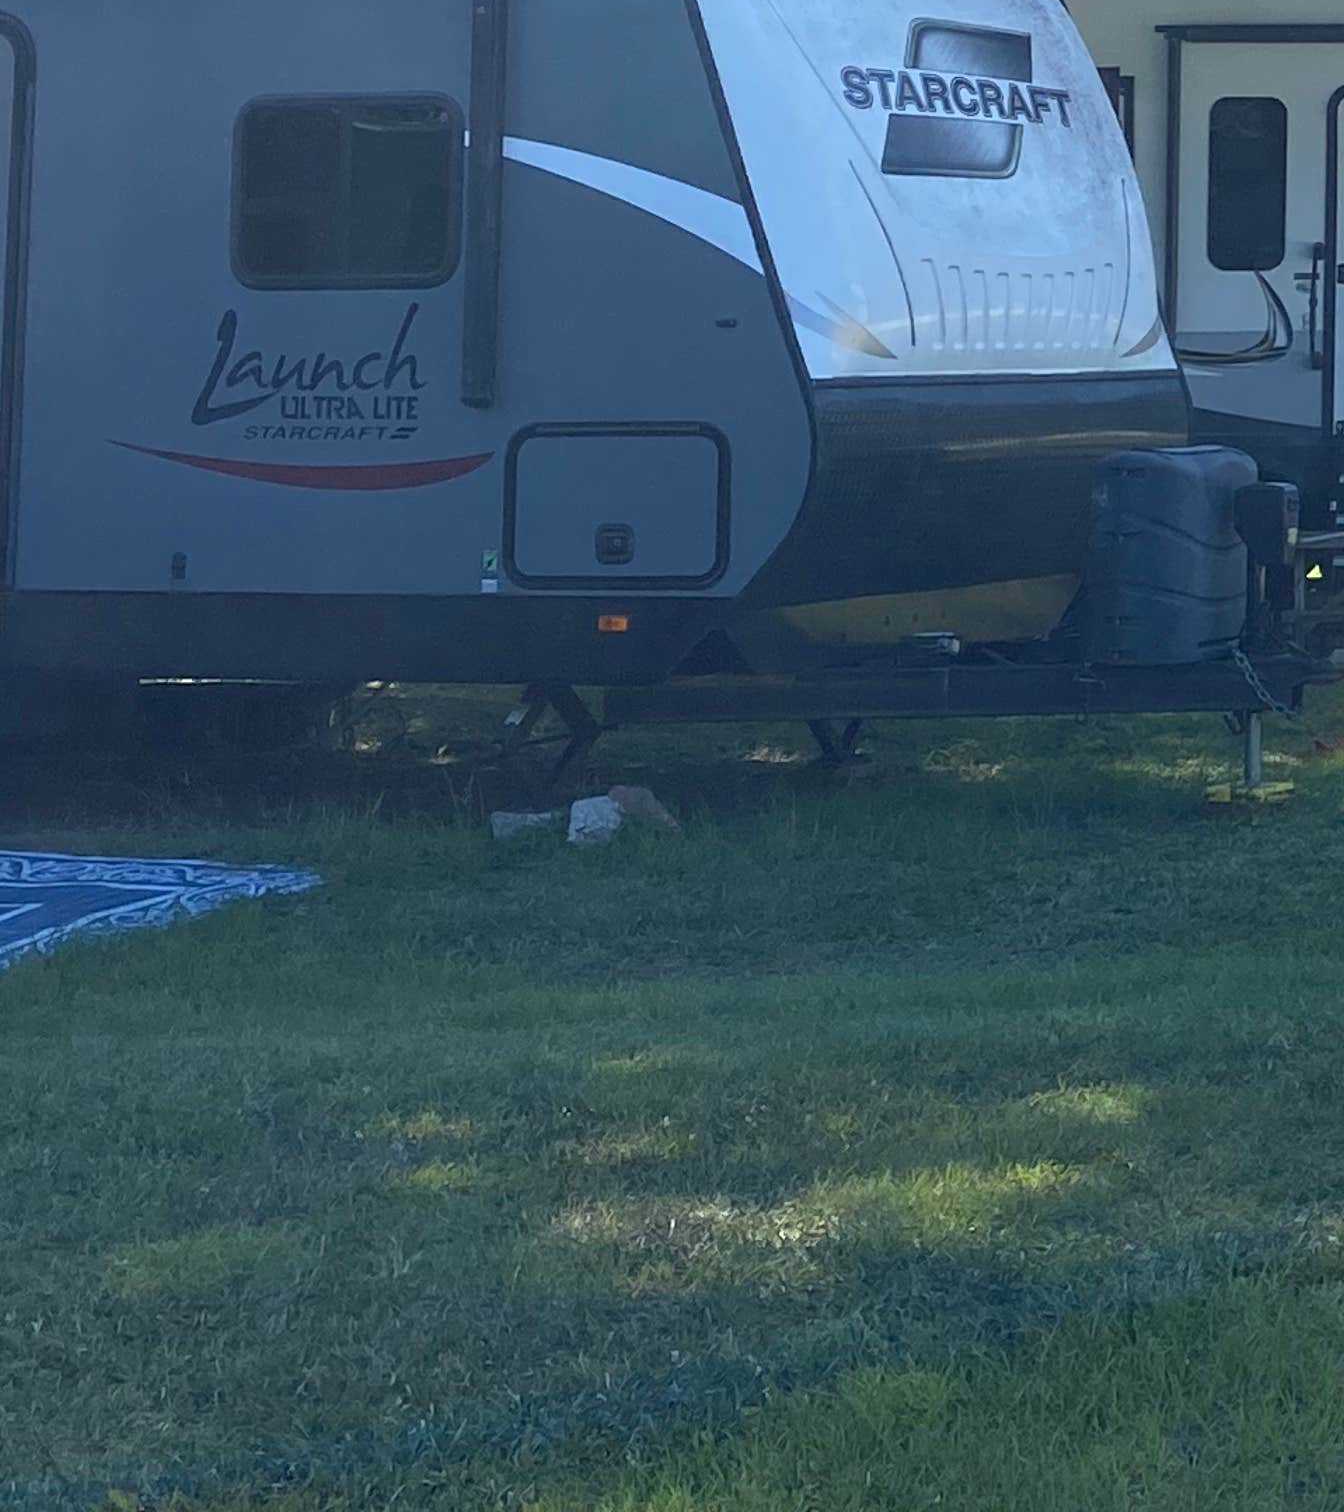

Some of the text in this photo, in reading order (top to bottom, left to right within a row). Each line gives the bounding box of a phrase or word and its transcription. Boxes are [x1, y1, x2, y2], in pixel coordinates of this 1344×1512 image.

[840, 65, 1072, 128] STARCRAFT
[191, 301, 428, 426] Launch
[281, 396, 418, 420] ULTRA LITE
[243, 425, 388, 440] STARCRAFT
